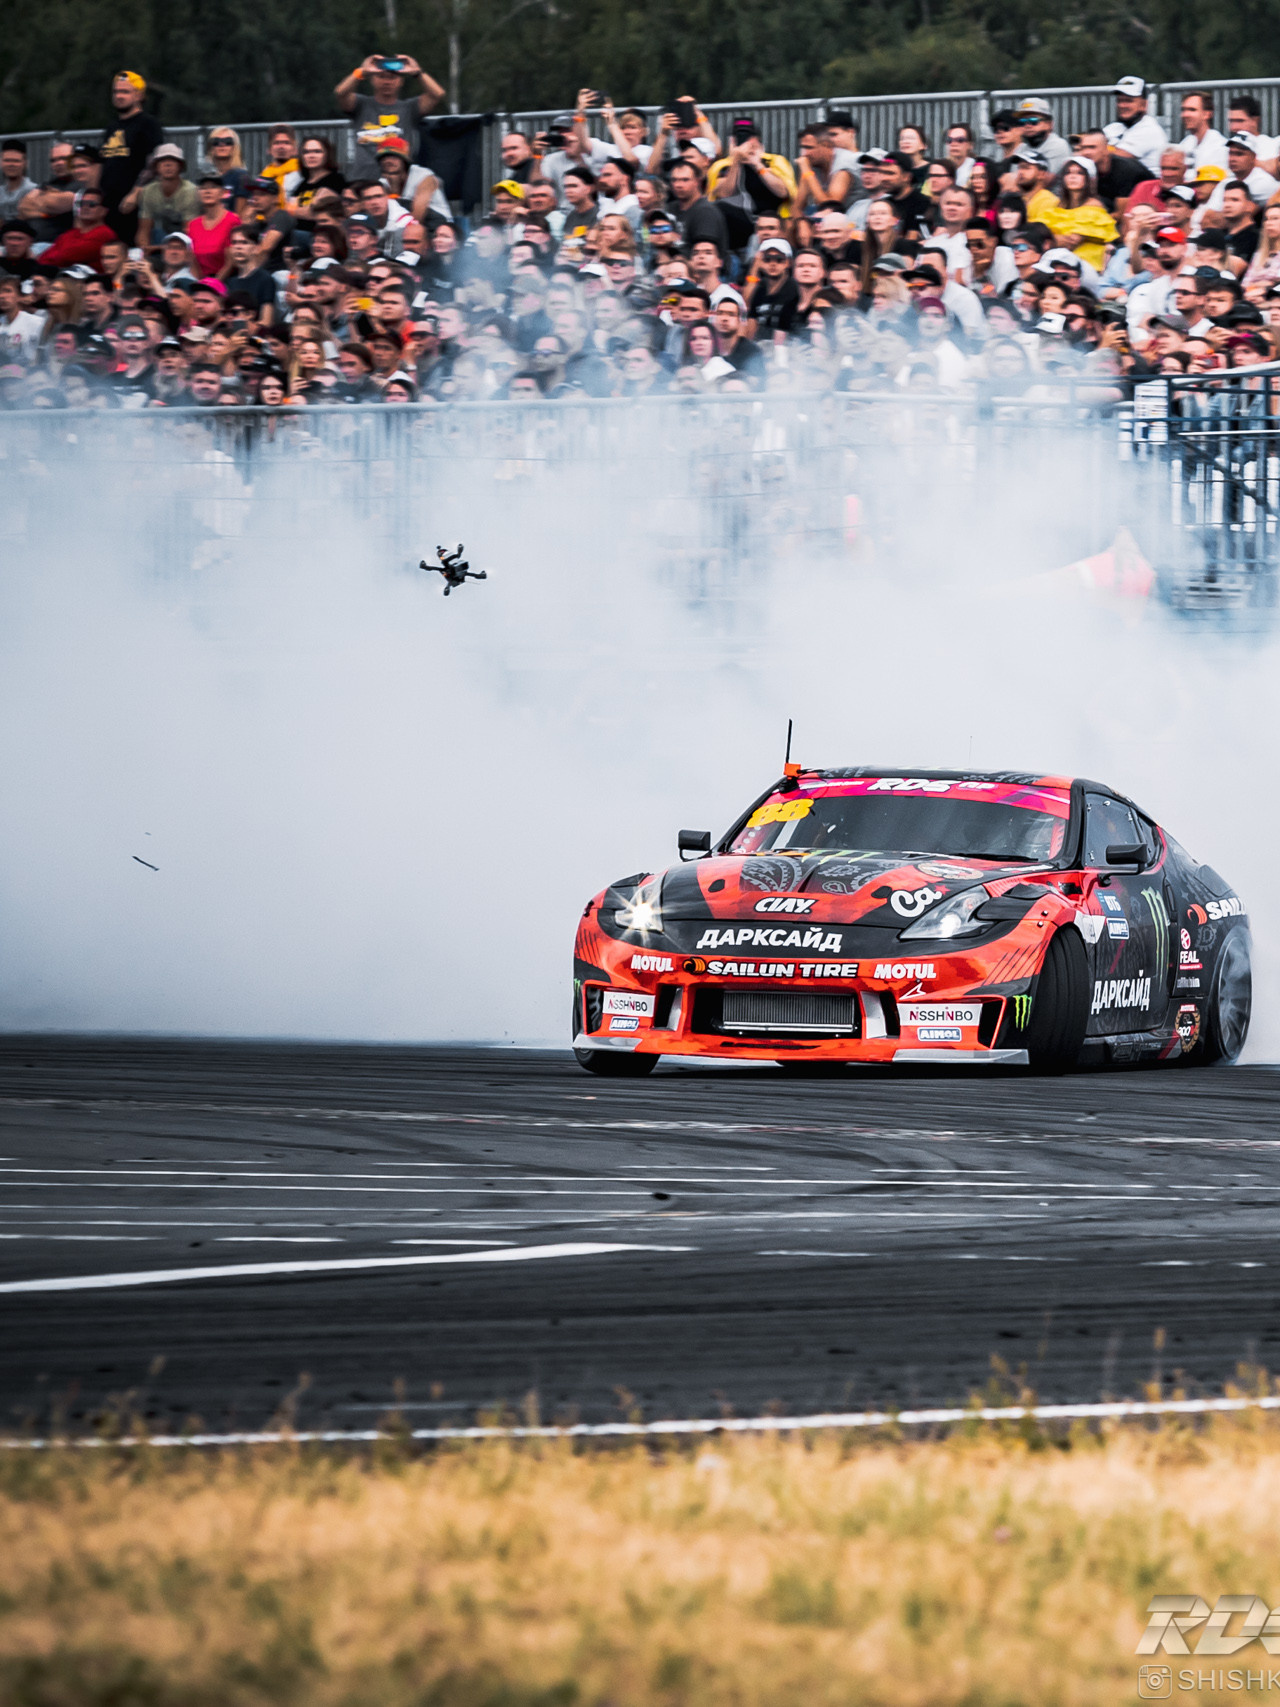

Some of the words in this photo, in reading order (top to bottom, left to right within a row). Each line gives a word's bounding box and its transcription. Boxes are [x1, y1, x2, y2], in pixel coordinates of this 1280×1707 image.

[867, 777, 962, 793] RDS
[696, 926, 843, 953] ДАРКСАЙД
[631, 954, 674, 972] MOTUL
[1179, 950, 1200, 964] FEAL
[706, 960, 795, 979] SAILUN
[799, 962, 859, 979] TIRE
[873, 963, 937, 979] MOTUL
[1091, 969, 1151, 1015] ДАРКСАЙД
[919, 1029, 960, 1039] AIMOL
